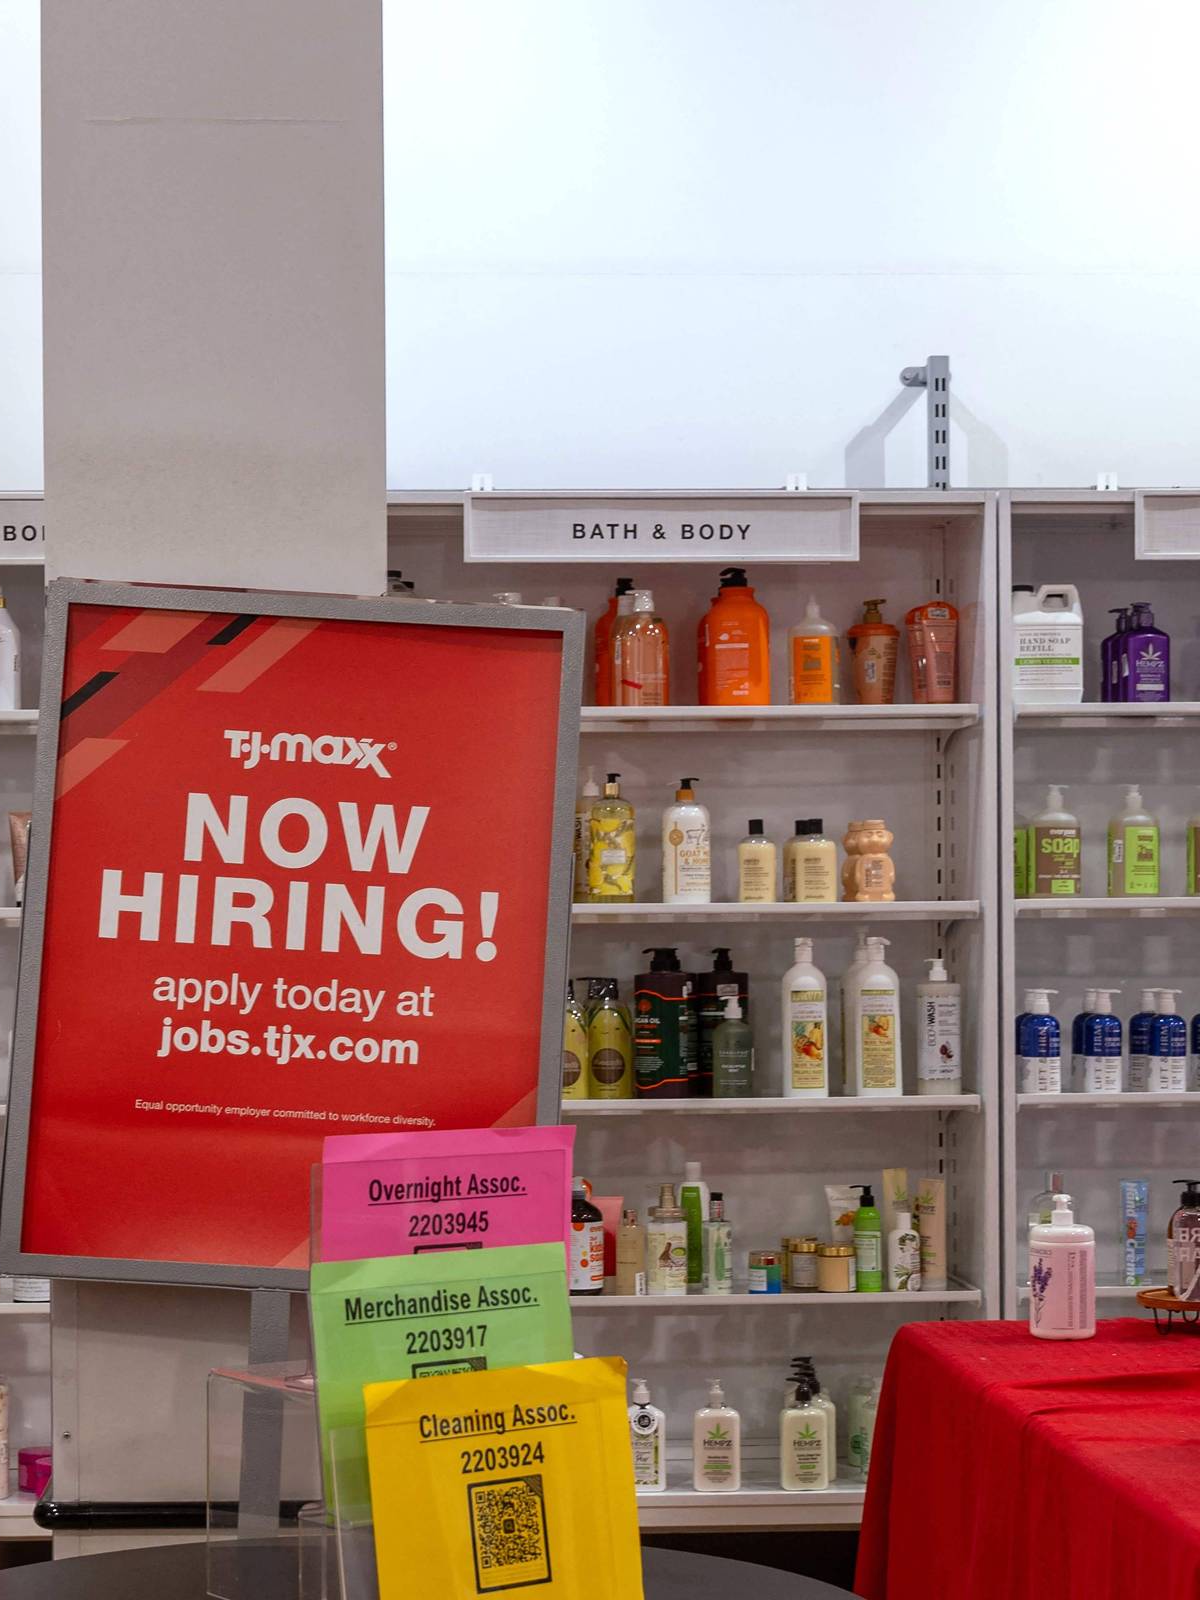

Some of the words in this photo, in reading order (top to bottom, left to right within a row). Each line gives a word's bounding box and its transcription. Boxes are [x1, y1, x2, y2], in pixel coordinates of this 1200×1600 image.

[3, 525, 45, 541] BO
[572, 523, 638, 539] BATH
[652, 524, 667, 539] &
[681, 524, 751, 540] BODY
[184, 793, 430, 874] NOW
[99, 869, 499, 962] HIRING!
[153, 973, 263, 1015] apply
[273, 978, 386, 1023] today
[396, 986, 435, 1017] at
[157, 1017, 419, 1065] jobs.tjx.com
[135, 1098, 164, 1111] Equal
[165, 1101, 223, 1116] opportunity
[224, 1106, 271, 1120] employer
[273, 1107, 327, 1120] committed
[328, 1111, 340, 1121] to
[341, 1111, 391, 1124] workforce
[393, 1115, 436, 1128] diversity.
[369, 1175, 462, 1203] Overnight
[467, 1173, 527, 1196] Assoc.
[408, 1211, 489, 1237] 2203945
[344, 1289, 472, 1321] Merchandise
[477, 1285, 538, 1308] Assoc.
[405, 1325, 488, 1355] 2203917
[419, 1409, 506, 1438] Cleaning
[512, 1404, 576, 1427] Assoc.
[461, 1441, 545, 1474] 2203924
[793, 1439, 822, 1447] HEMPZ
